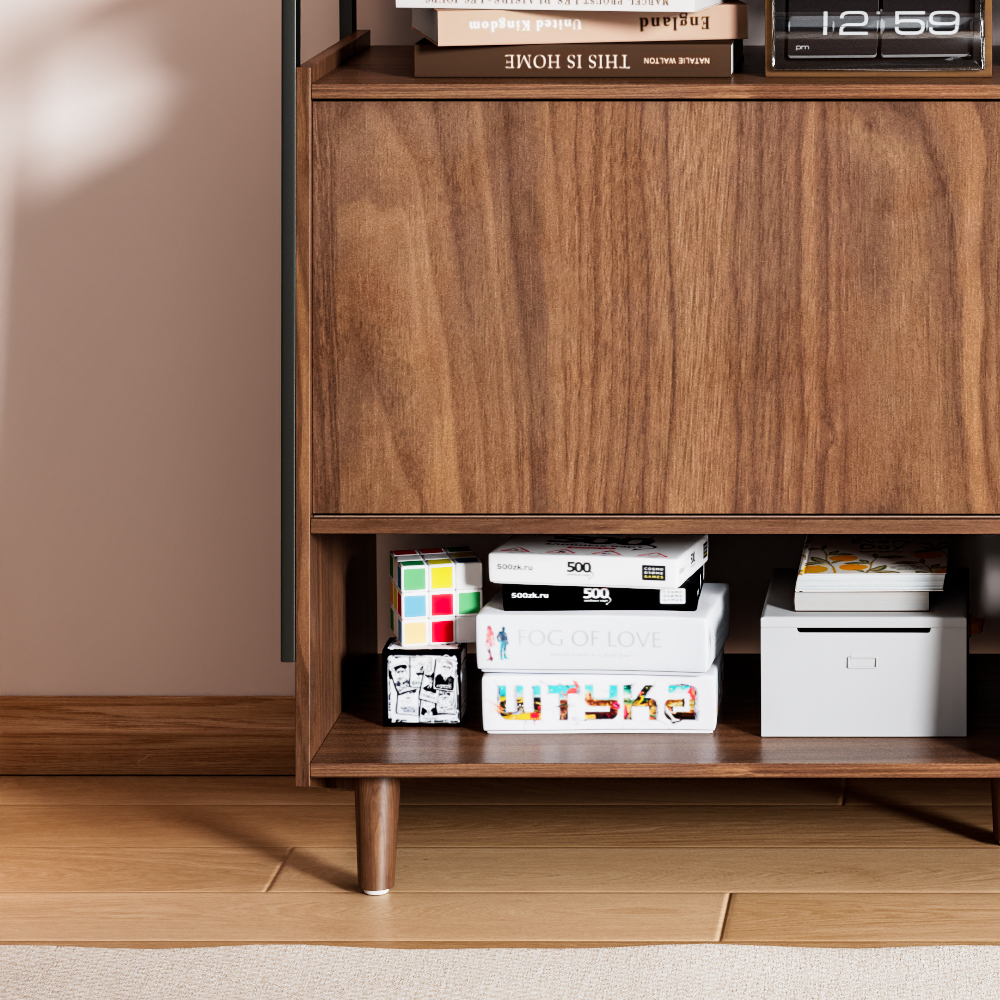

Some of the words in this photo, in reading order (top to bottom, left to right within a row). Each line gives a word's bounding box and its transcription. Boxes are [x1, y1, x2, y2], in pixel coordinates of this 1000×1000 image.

[468, 16, 531, 33] Kingdom
[535, 17, 583, 32] United
[639, 12, 710, 32] England
[822, 10, 869, 36] 12
[894, 10, 961, 36] 59
[795, 44, 810, 52] pm
[504, 53, 561, 69] HOME
[567, 53, 583, 70] IS
[588, 53, 631, 70] THIS
[643, 56, 677, 65] WALTON
[678, 56, 711, 65] NATALIE
[859, 543, 905, 551] Day
[496, 563, 533, 571] 500zk.ru
[566, 561, 592, 573] 500
[510, 591, 550, 599] 500zk.ru
[582, 587, 610, 600] 500
[517, 628, 564, 647] FOG
[570, 629, 601, 648] OF
[607, 630, 663, 649] LOVE
